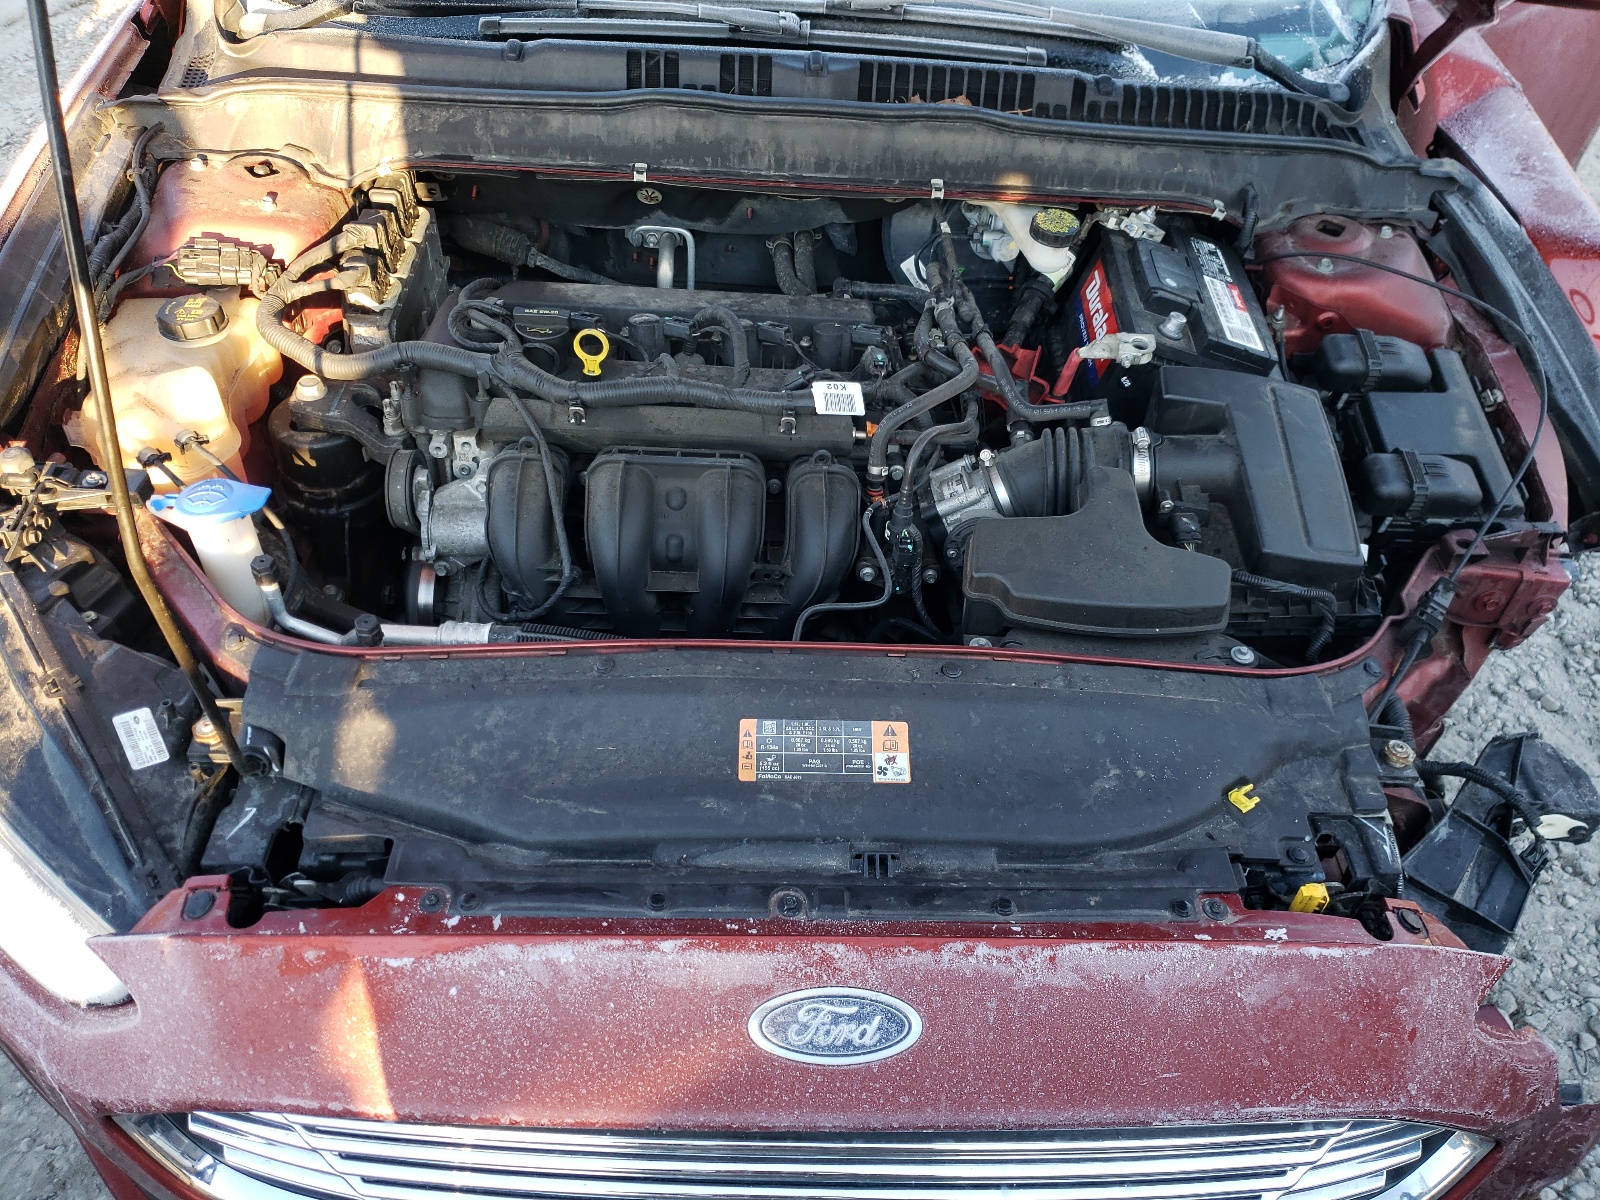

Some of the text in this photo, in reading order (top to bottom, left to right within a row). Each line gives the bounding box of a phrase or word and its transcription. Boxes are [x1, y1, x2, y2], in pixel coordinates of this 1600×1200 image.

[1085, 269, 1109, 341] Durala
[826, 383, 847, 391] K02
[788, 1003, 883, 1047] Ford
